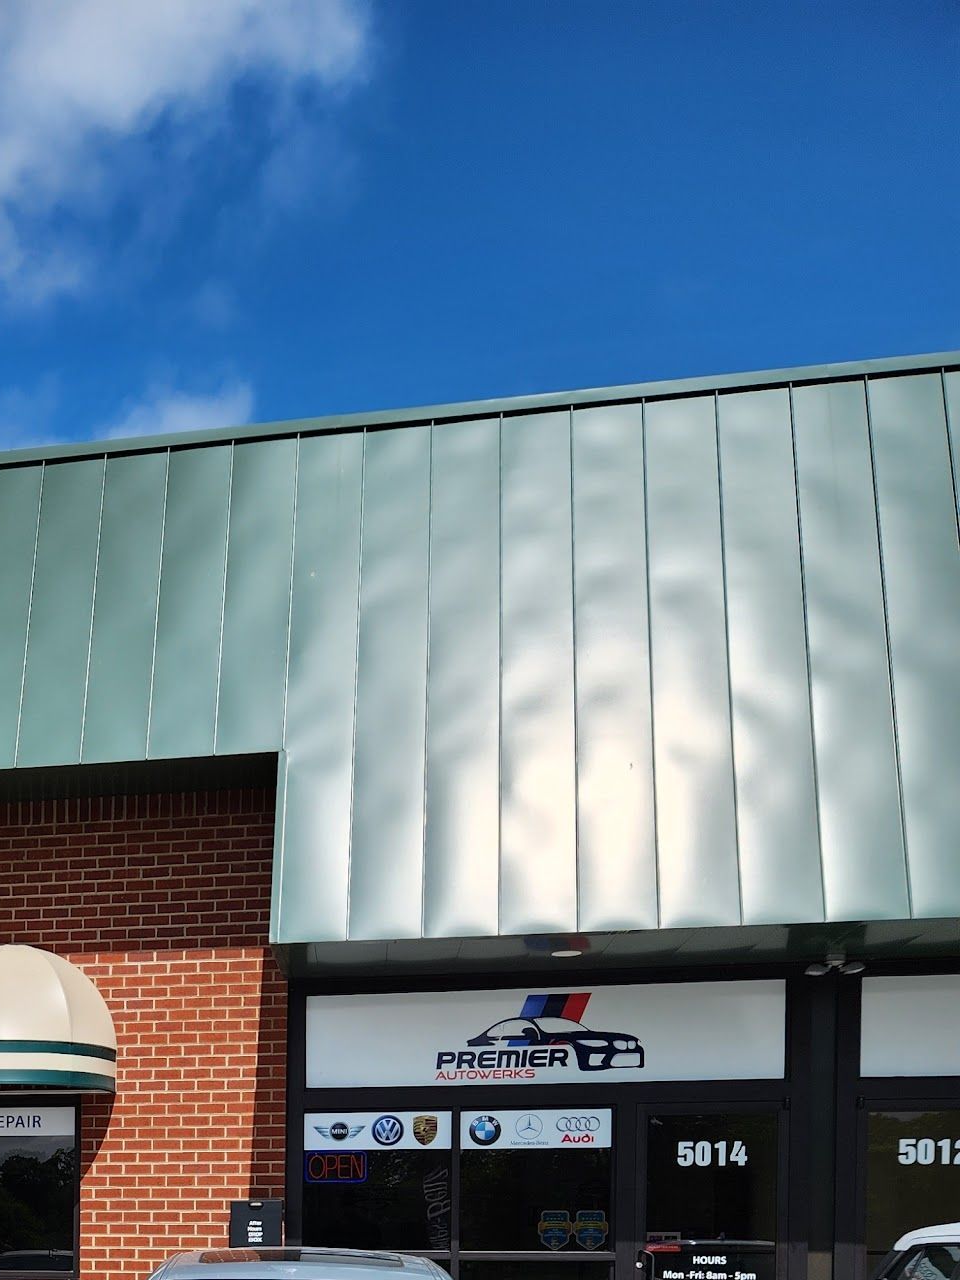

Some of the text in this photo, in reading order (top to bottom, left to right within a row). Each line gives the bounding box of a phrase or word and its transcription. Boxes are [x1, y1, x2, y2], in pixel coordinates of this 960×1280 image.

[436, 1049, 569, 1070] PREMIER
[435, 1069, 536, 1081] AUTOWERKS
[331, 1127, 348, 1135] MINI
[561, 1134, 594, 1143] Audi
[676, 1140, 748, 1167] 5014
[308, 1154, 364, 1180] OPEN
[692, 1255, 728, 1265] HOURS
[662, 1270, 685, 1279] Mon
[705, 1271, 728, 1280] 8am
